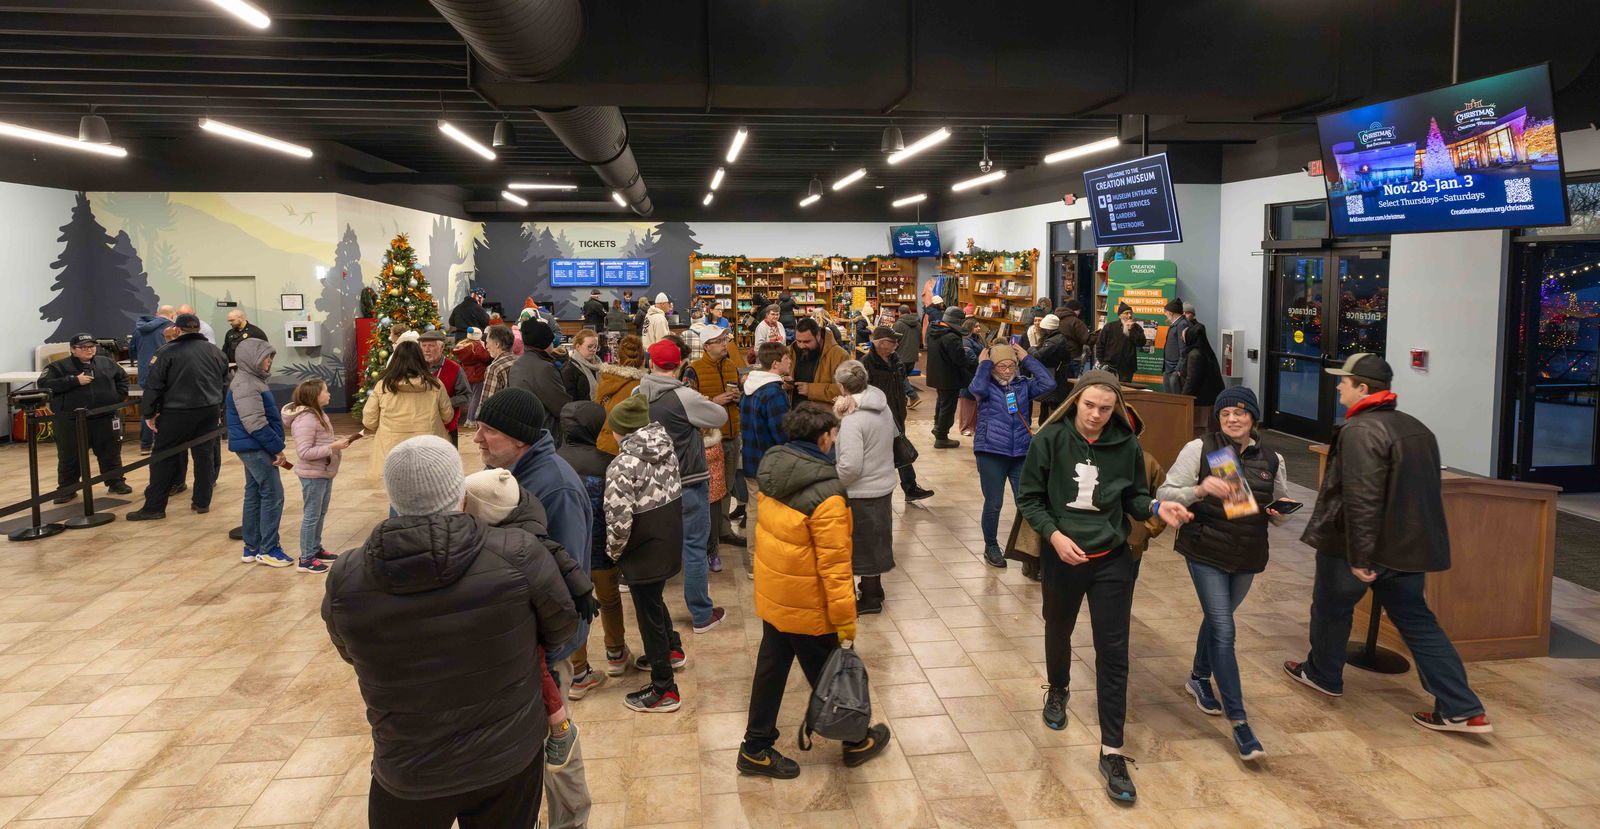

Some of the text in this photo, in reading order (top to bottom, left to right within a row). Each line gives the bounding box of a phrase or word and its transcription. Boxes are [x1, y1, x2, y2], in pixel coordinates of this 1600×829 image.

[1455, 107, 1495, 123] CHRISTMAS
[1362, 130, 1392, 142] CHRISTMAS
[1312, 160, 1324, 175] EXI
[1096, 172, 1155, 190] CREATION MUSEUM
[1384, 184, 1410, 196] Nov.
[1464, 175, 1474, 188] 3
[1112, 188, 1158, 200] MUSEUM ENTRANCE
[1114, 199, 1150, 210] GUEST SERVICES
[1378, 198, 1399, 208] Select
[1116, 211, 1136, 219] GARDENS
[1450, 204, 1534, 216] CreationMuseum.org/christmas
[1349, 214, 1405, 222] ArkEncounter.com/christmas
[1117, 221, 1144, 229] RESTROOMS
